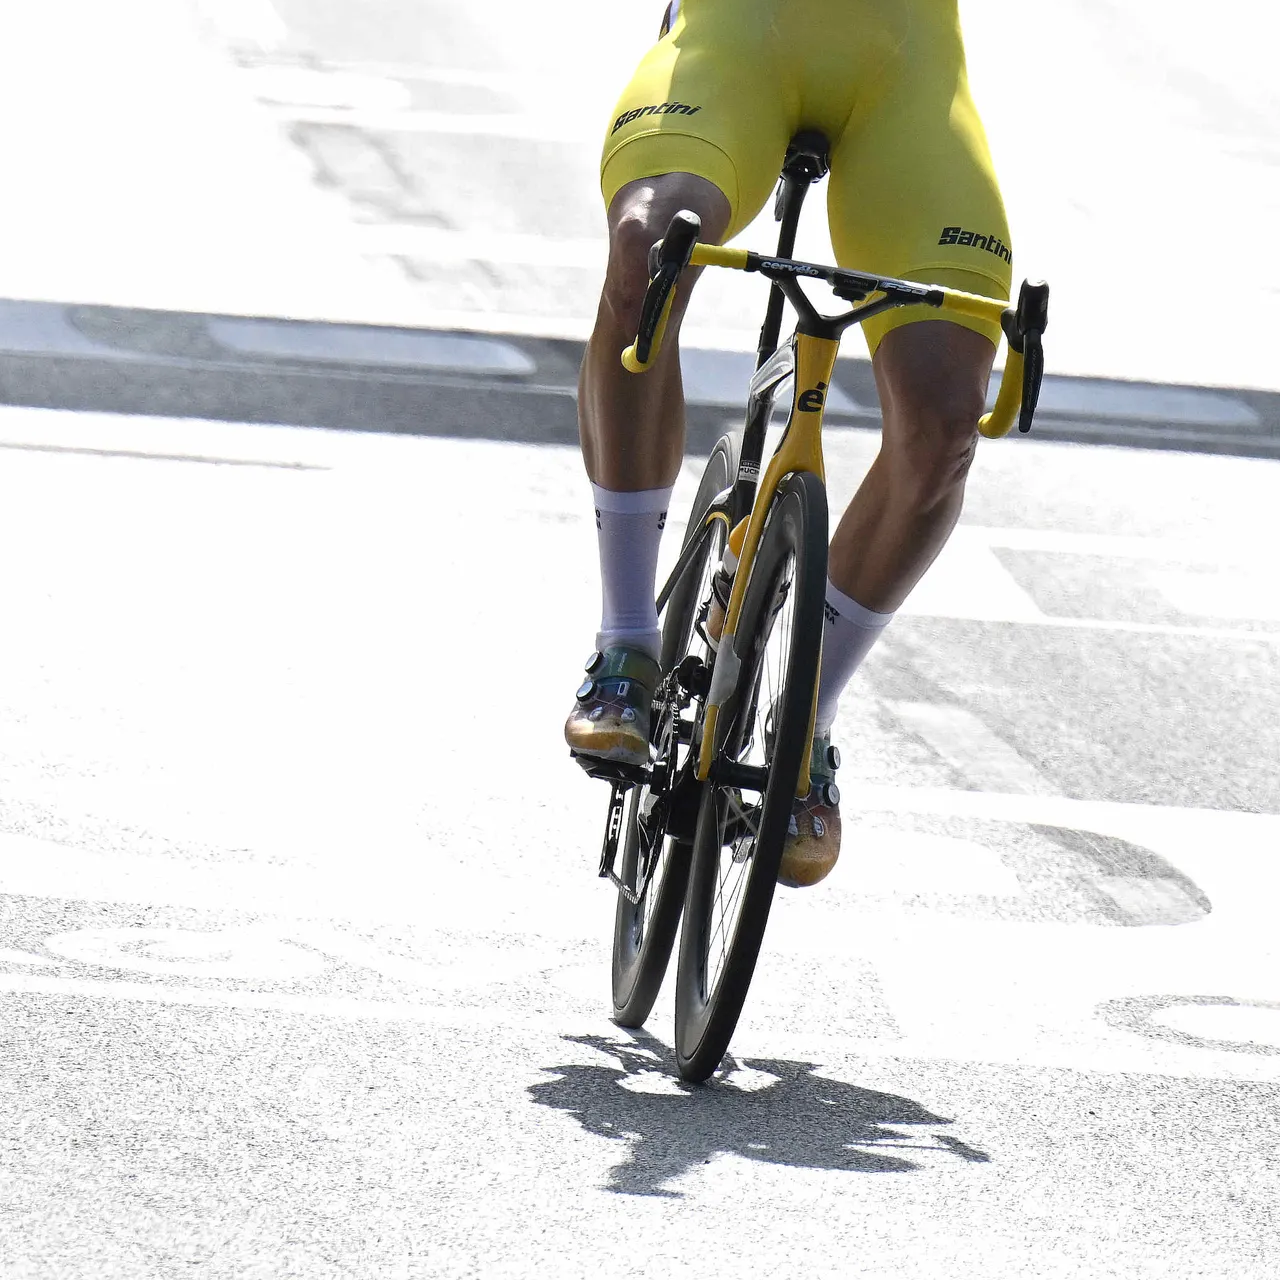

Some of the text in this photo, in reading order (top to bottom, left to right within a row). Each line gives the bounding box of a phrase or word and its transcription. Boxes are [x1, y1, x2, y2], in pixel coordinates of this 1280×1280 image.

[611, 102, 703, 137] Santini
[938, 227, 1012, 265] Santini
[761, 260, 819, 277] cervélo
